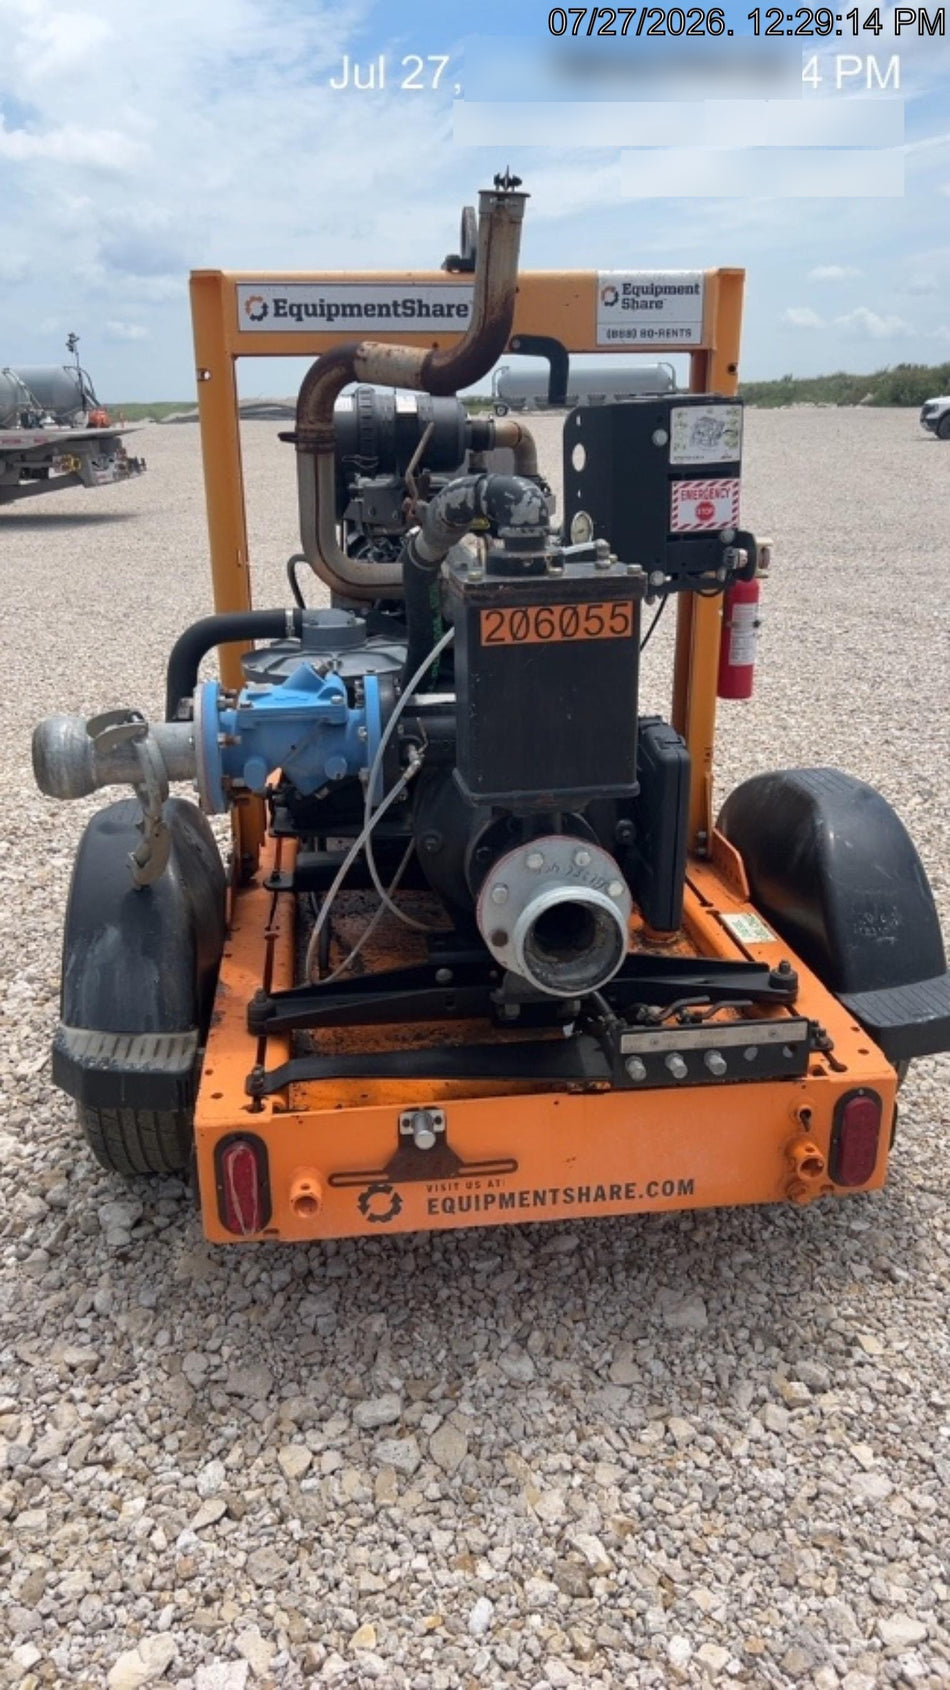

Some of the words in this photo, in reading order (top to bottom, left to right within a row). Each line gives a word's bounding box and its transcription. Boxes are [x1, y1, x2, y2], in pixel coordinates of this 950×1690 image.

[622, 283, 700, 298] Equipment
[272, 298, 469, 322] EquipmentShare
[621, 298, 664, 310] Share
[681, 488, 730, 501] EMERGENCY
[484, 603, 630, 643] 206055
[426, 1182, 459, 1193] VISIT
[465, 1180, 481, 1190] US
[427, 1178, 695, 1216] EQUIPMENTSHARE.COM
